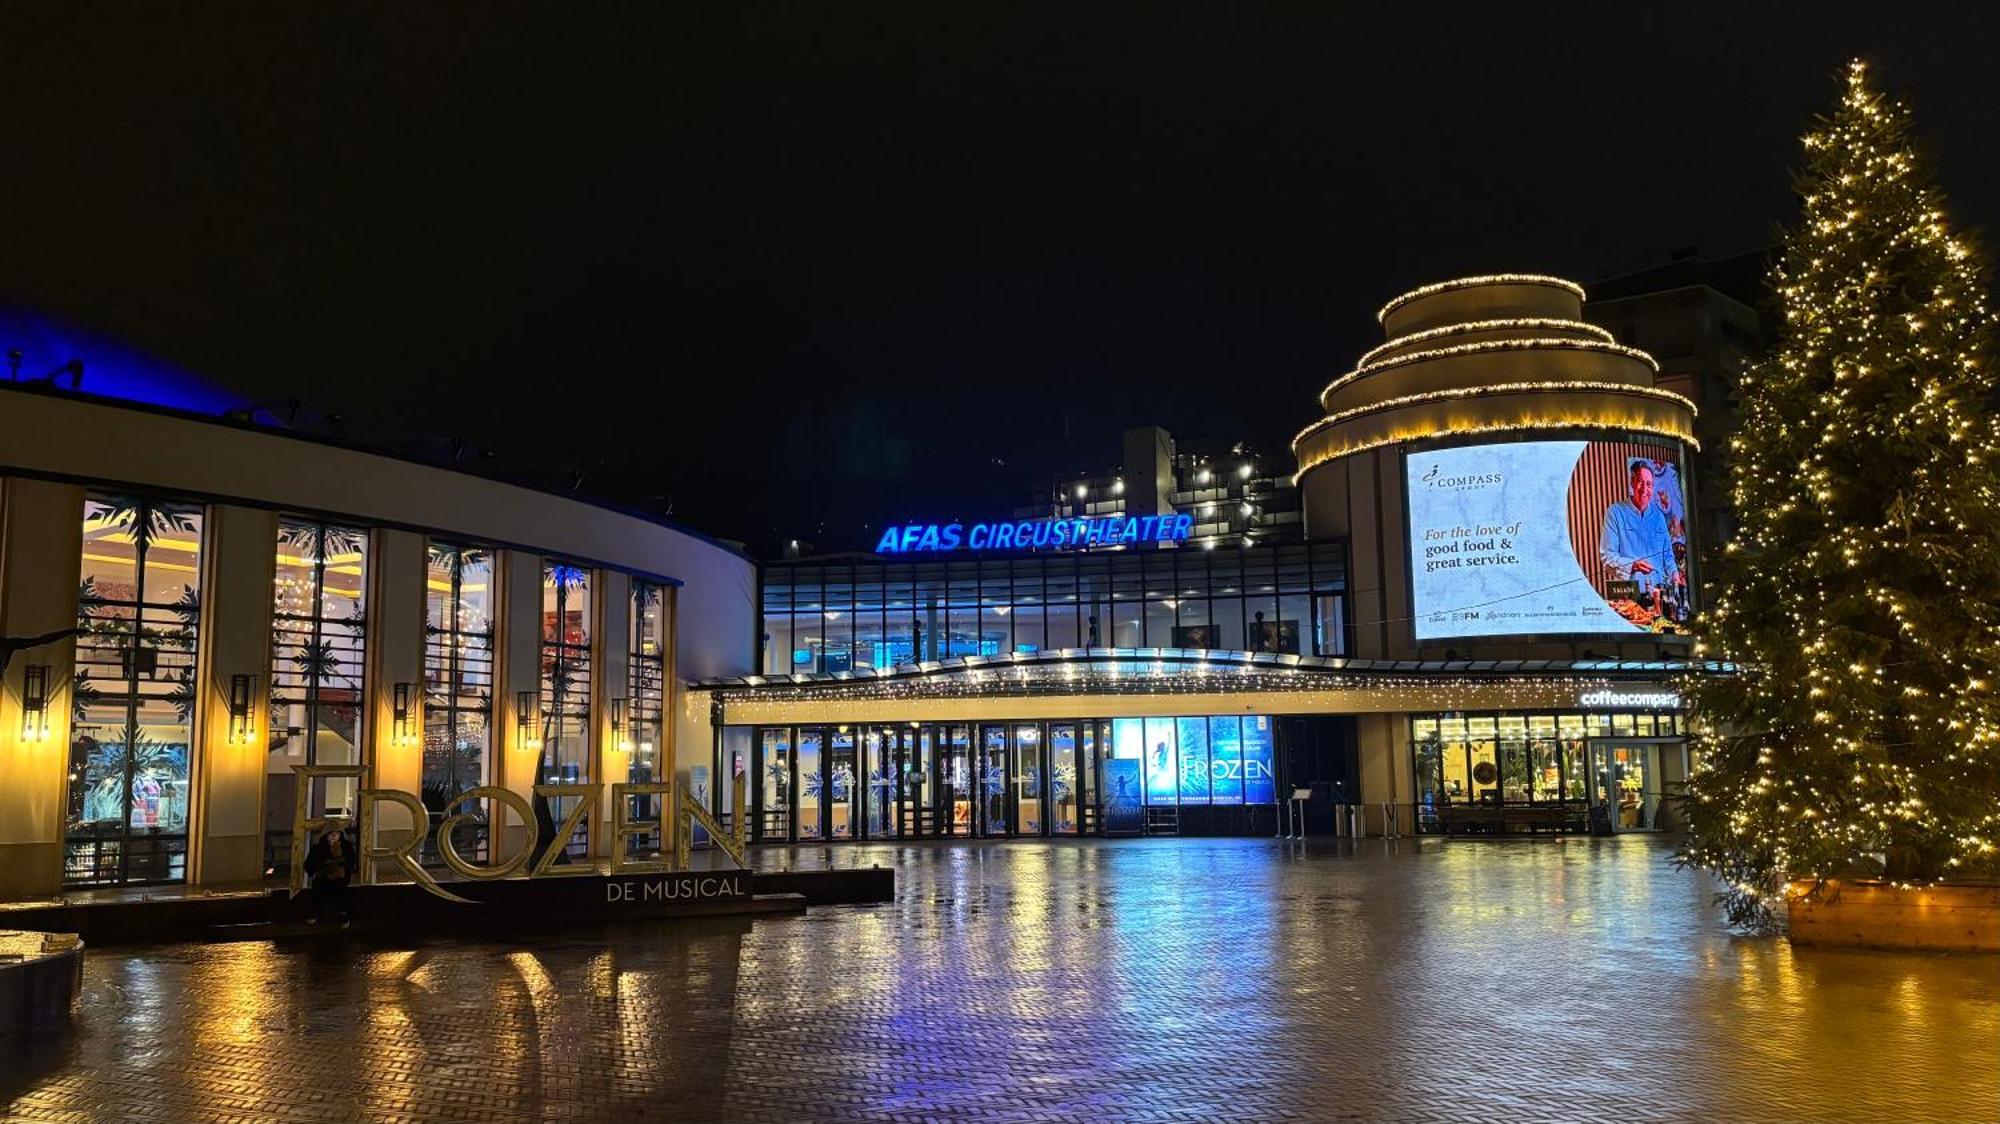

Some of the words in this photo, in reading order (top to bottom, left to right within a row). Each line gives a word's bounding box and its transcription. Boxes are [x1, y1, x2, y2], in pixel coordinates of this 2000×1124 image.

[1437, 474, 1502, 488] COMPASS
[875, 523, 963, 553] AFAS
[968, 514, 1193, 550] CIRCUSTHEATER
[1425, 528, 1447, 541] For
[1451, 526, 1472, 538] the
[1475, 524, 1502, 537] love
[1506, 521, 1522, 537] of
[1425, 540, 1459, 558] good
[1463, 538, 1495, 552] food
[1500, 538, 1513, 549] &
[1426, 557, 1462, 573] great
[1466, 552, 1520, 567] service.
[1182, 755, 1272, 786] FROZEN
[290, 764, 746, 904] FROZEN
[607, 882, 635, 902] DE
[644, 876, 746, 900] MUSICAL
